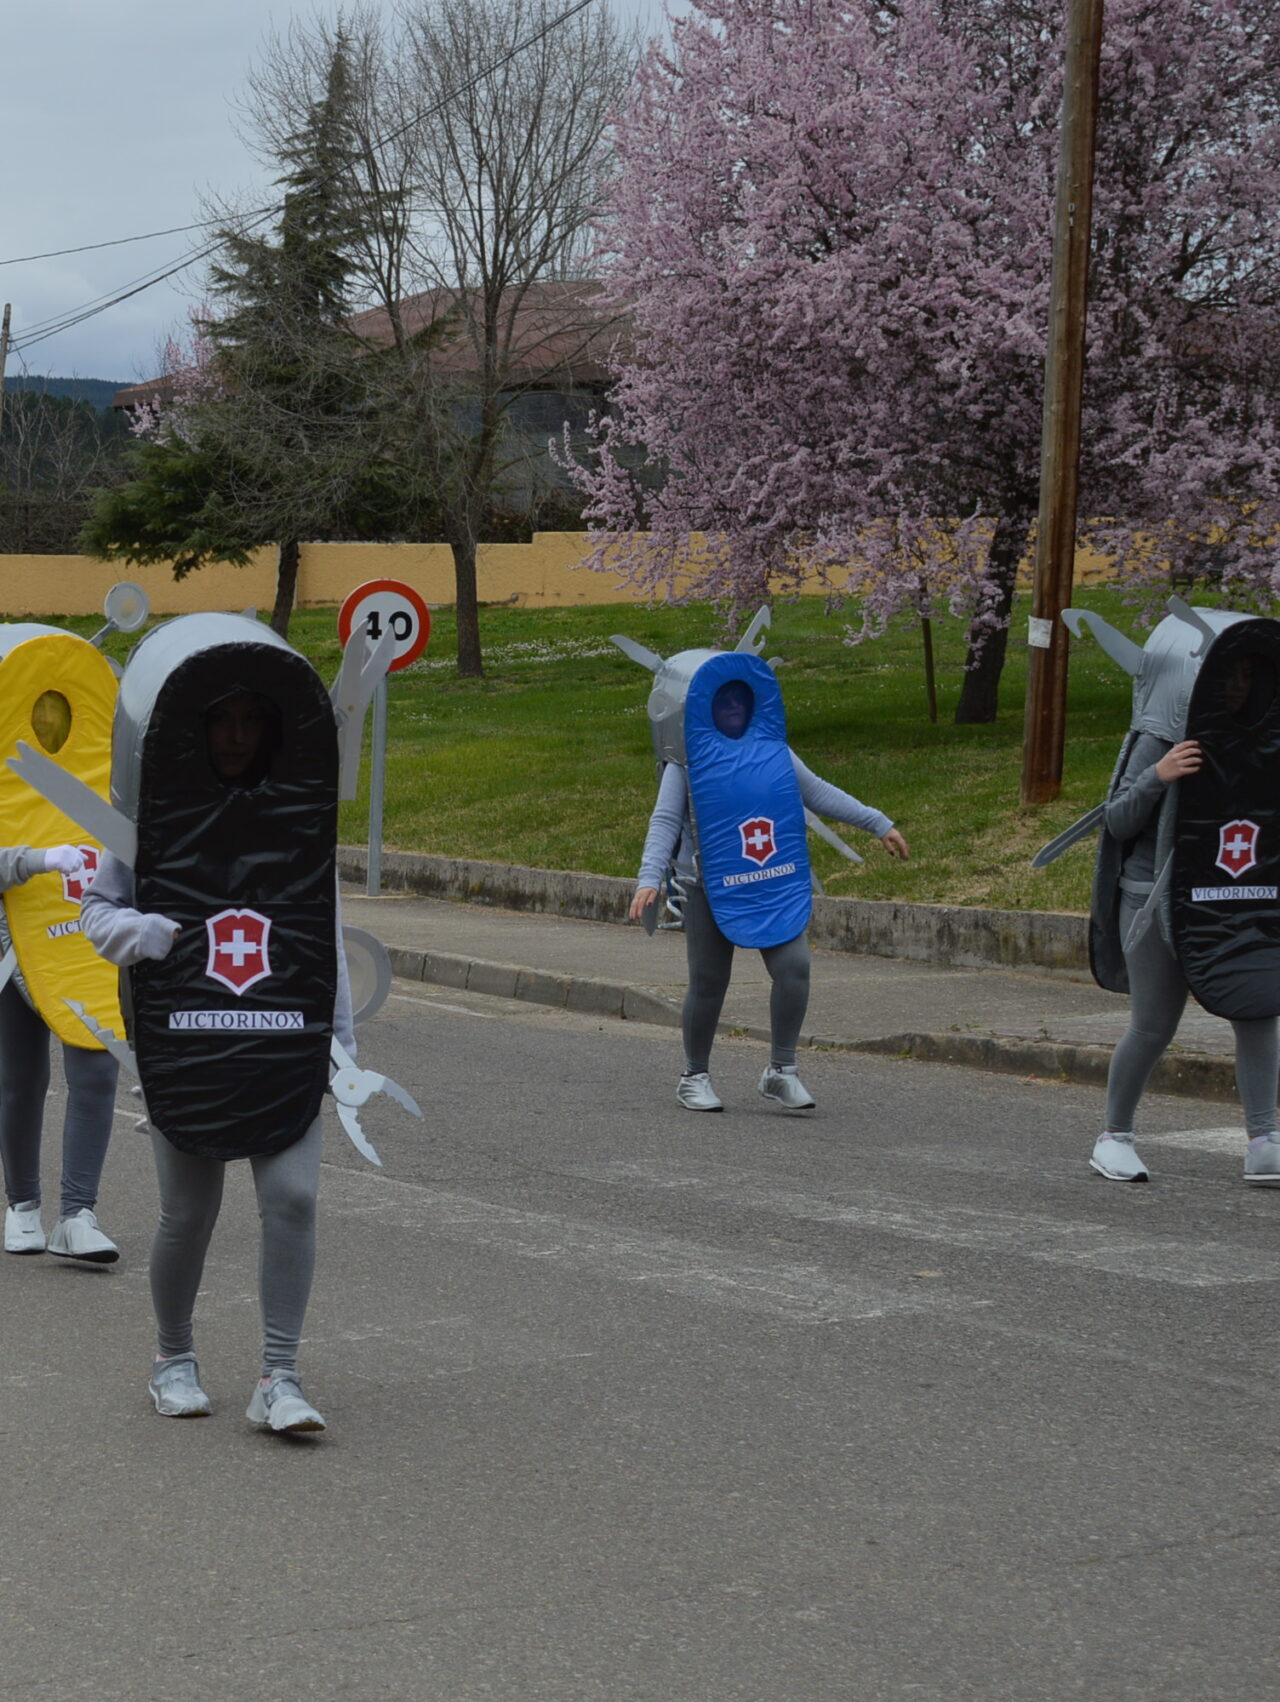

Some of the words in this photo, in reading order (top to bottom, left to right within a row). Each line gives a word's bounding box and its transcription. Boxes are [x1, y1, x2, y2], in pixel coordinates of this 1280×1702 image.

[365, 611, 413, 642] 40
[723, 863, 795, 886] VICTORINOX
[1194, 887, 1276, 900] VICTORINOX
[47, 919, 82, 938] VICT
[172, 1012, 303, 1029] VICTORINOX
